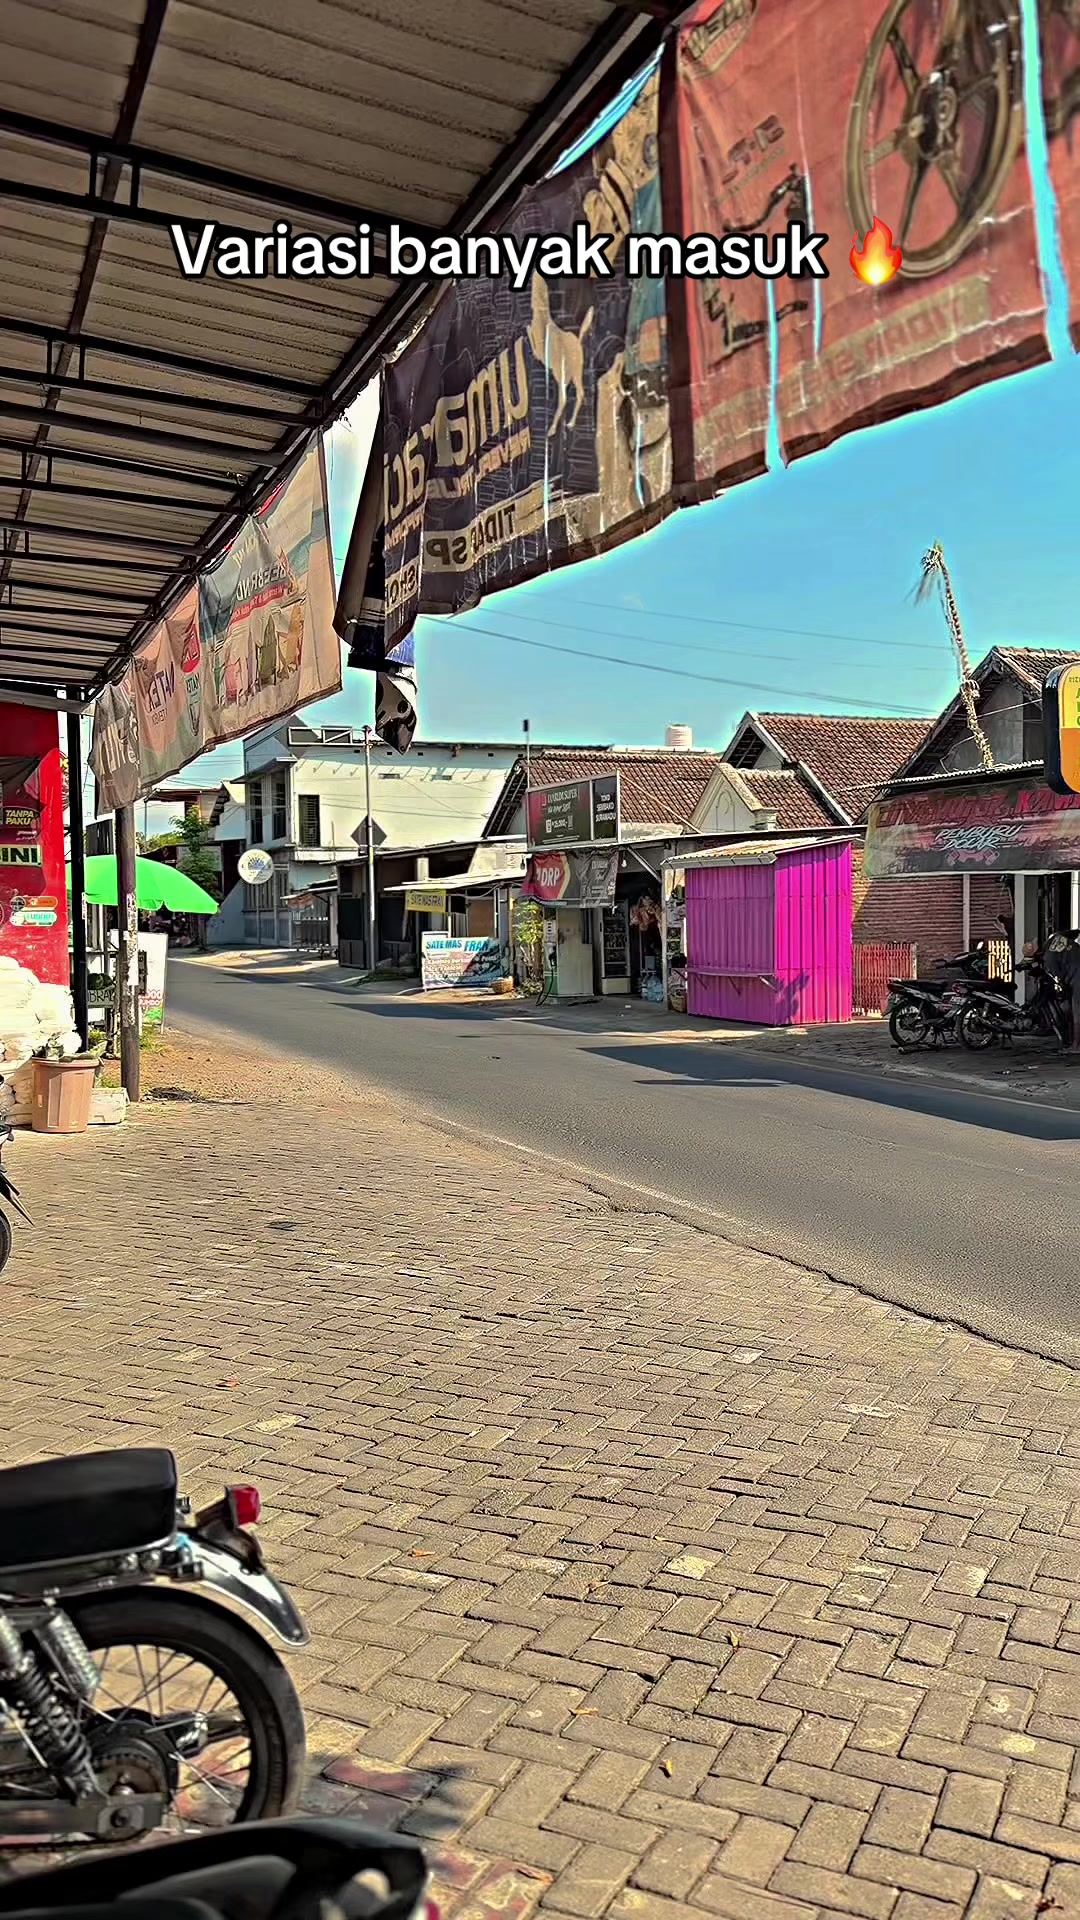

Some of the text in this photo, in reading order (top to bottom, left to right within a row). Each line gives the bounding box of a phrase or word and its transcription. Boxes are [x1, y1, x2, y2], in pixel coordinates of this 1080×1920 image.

[5, 809, 34, 819] TANPA
[5, 818, 32, 827] PAKU
[0, 847, 38, 864] INI
[426, 940, 444, 950] SATE
[445, 940, 463, 949] MAS
